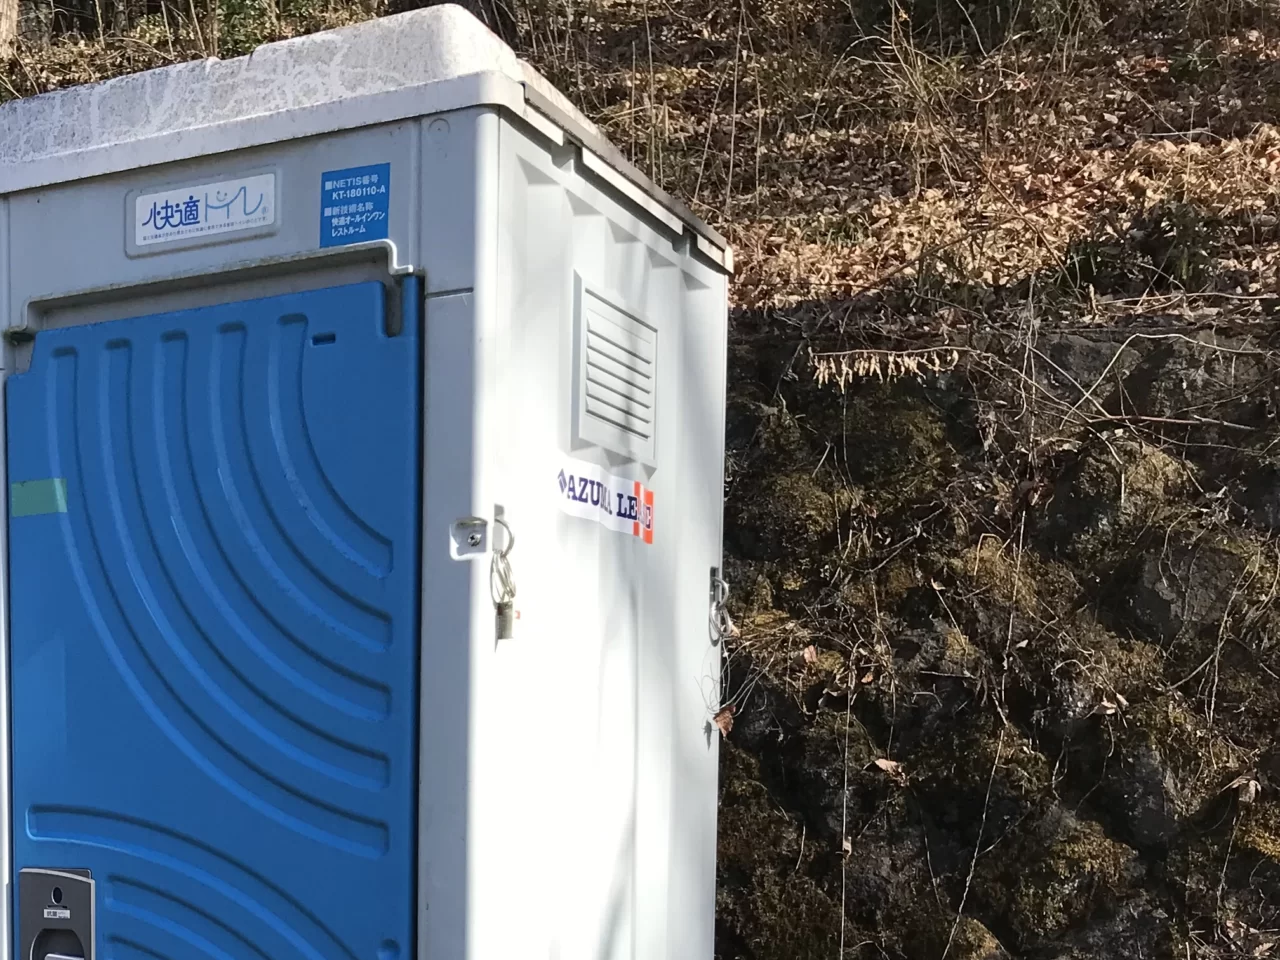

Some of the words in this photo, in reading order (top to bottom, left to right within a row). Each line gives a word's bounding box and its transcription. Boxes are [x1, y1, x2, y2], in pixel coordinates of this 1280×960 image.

[332, 185, 386, 200] KT-180110-A
[331, 224, 366, 237] レストルーム
[566, 474, 613, 516] AZUMA
[616, 492, 652, 529] LEE
